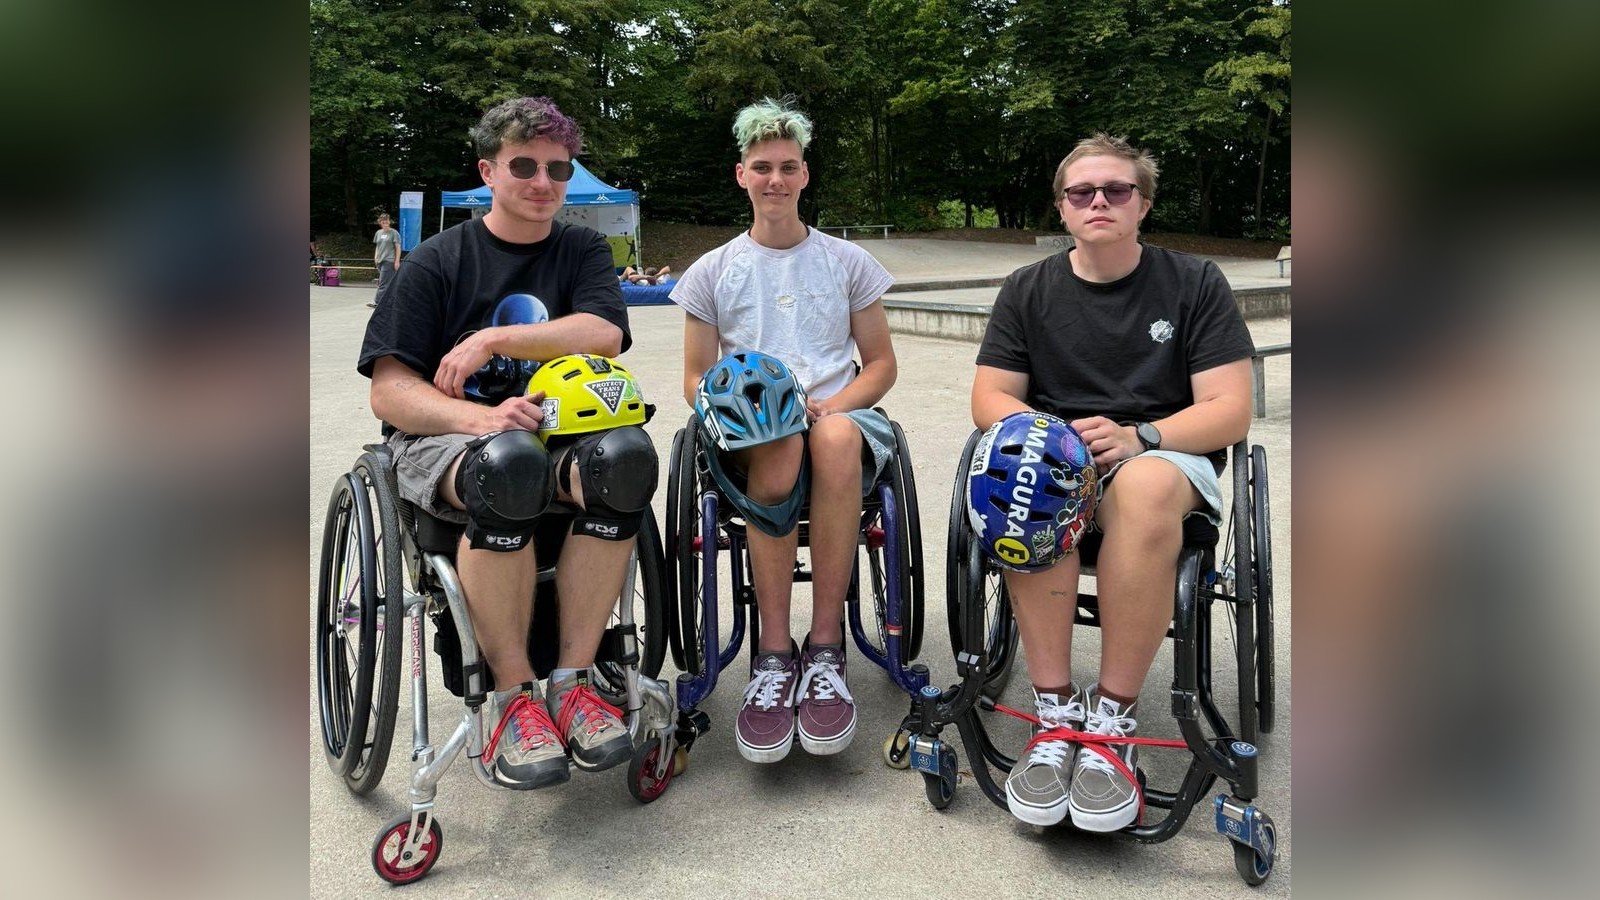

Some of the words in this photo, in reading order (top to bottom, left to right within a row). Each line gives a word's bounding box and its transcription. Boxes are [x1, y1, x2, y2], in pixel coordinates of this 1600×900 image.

[591, 381, 623, 389] PROTECT
[1004, 427, 1049, 538] MAGURA
[595, 523, 619, 534] TSG
[496, 535, 522, 545] TSG
[997, 542, 1026, 563] E
[412, 616, 421, 679] HURRICANE
